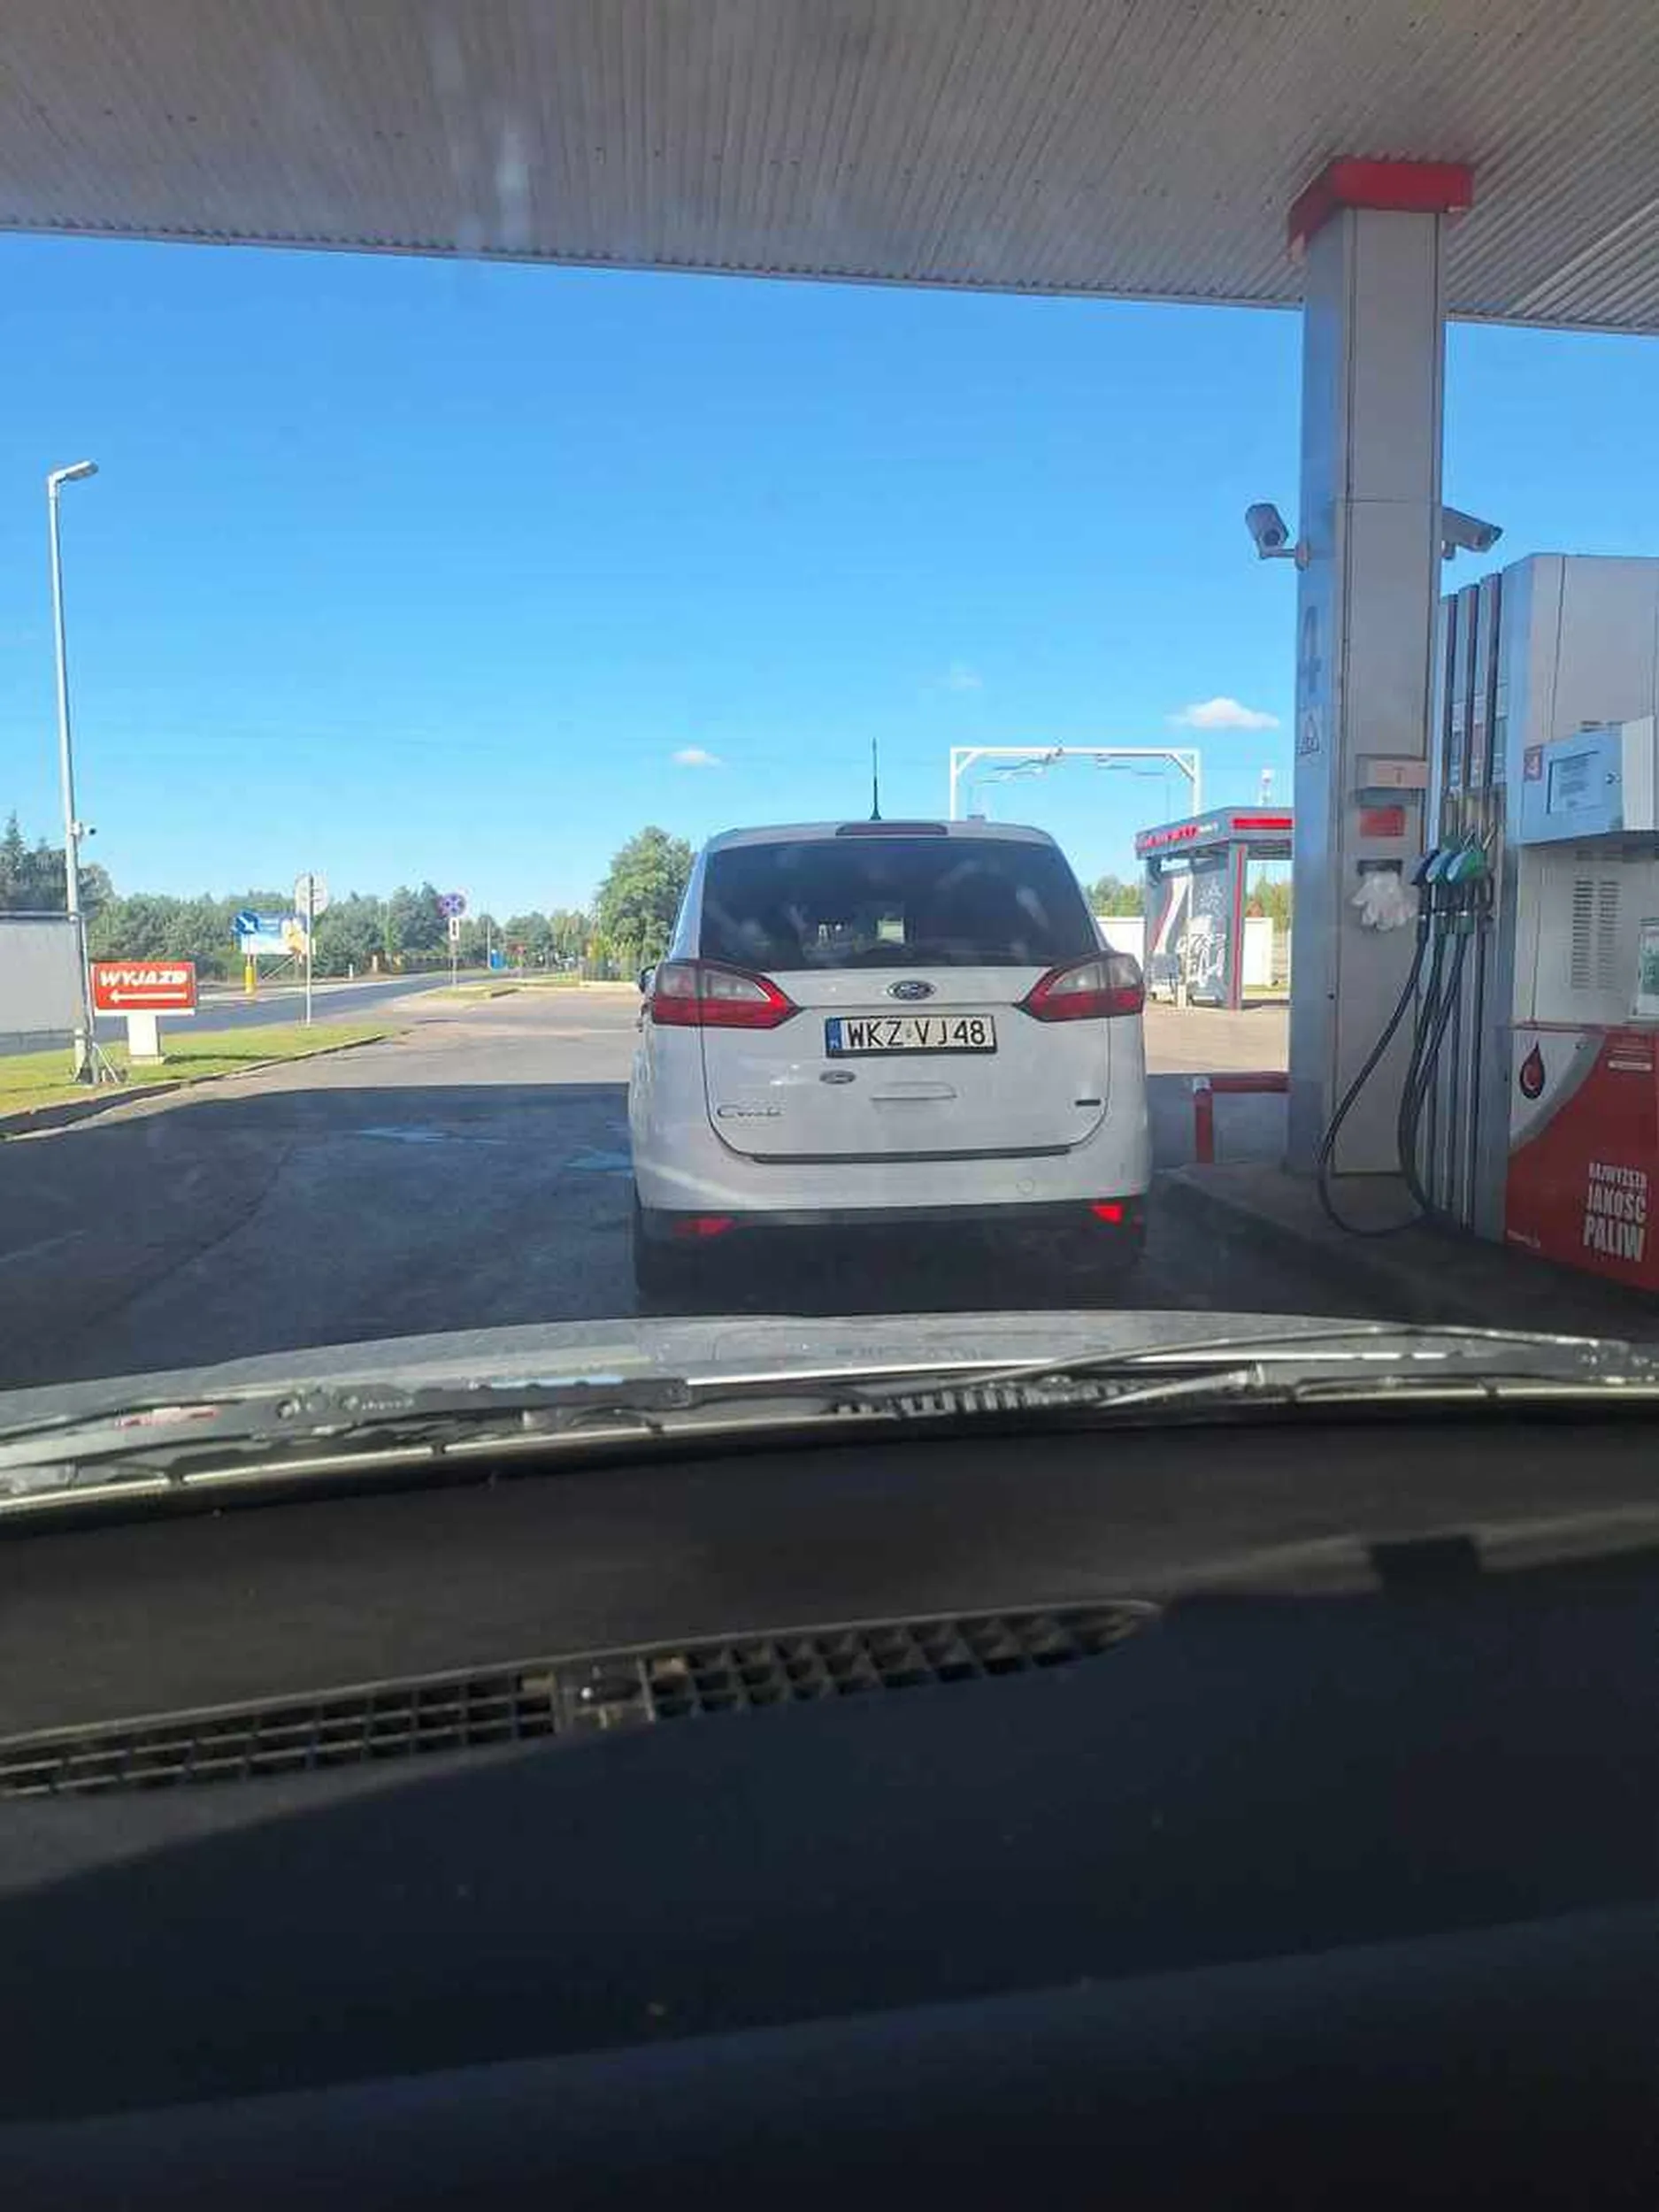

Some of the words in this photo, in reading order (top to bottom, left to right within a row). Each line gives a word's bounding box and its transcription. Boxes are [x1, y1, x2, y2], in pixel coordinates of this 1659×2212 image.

[99, 971, 188, 987] WYJAZD
[847, 1020, 903, 1048] WKZ
[915, 1019, 986, 1046] VJ48
[1583, 1214, 1646, 1263] PALIW
